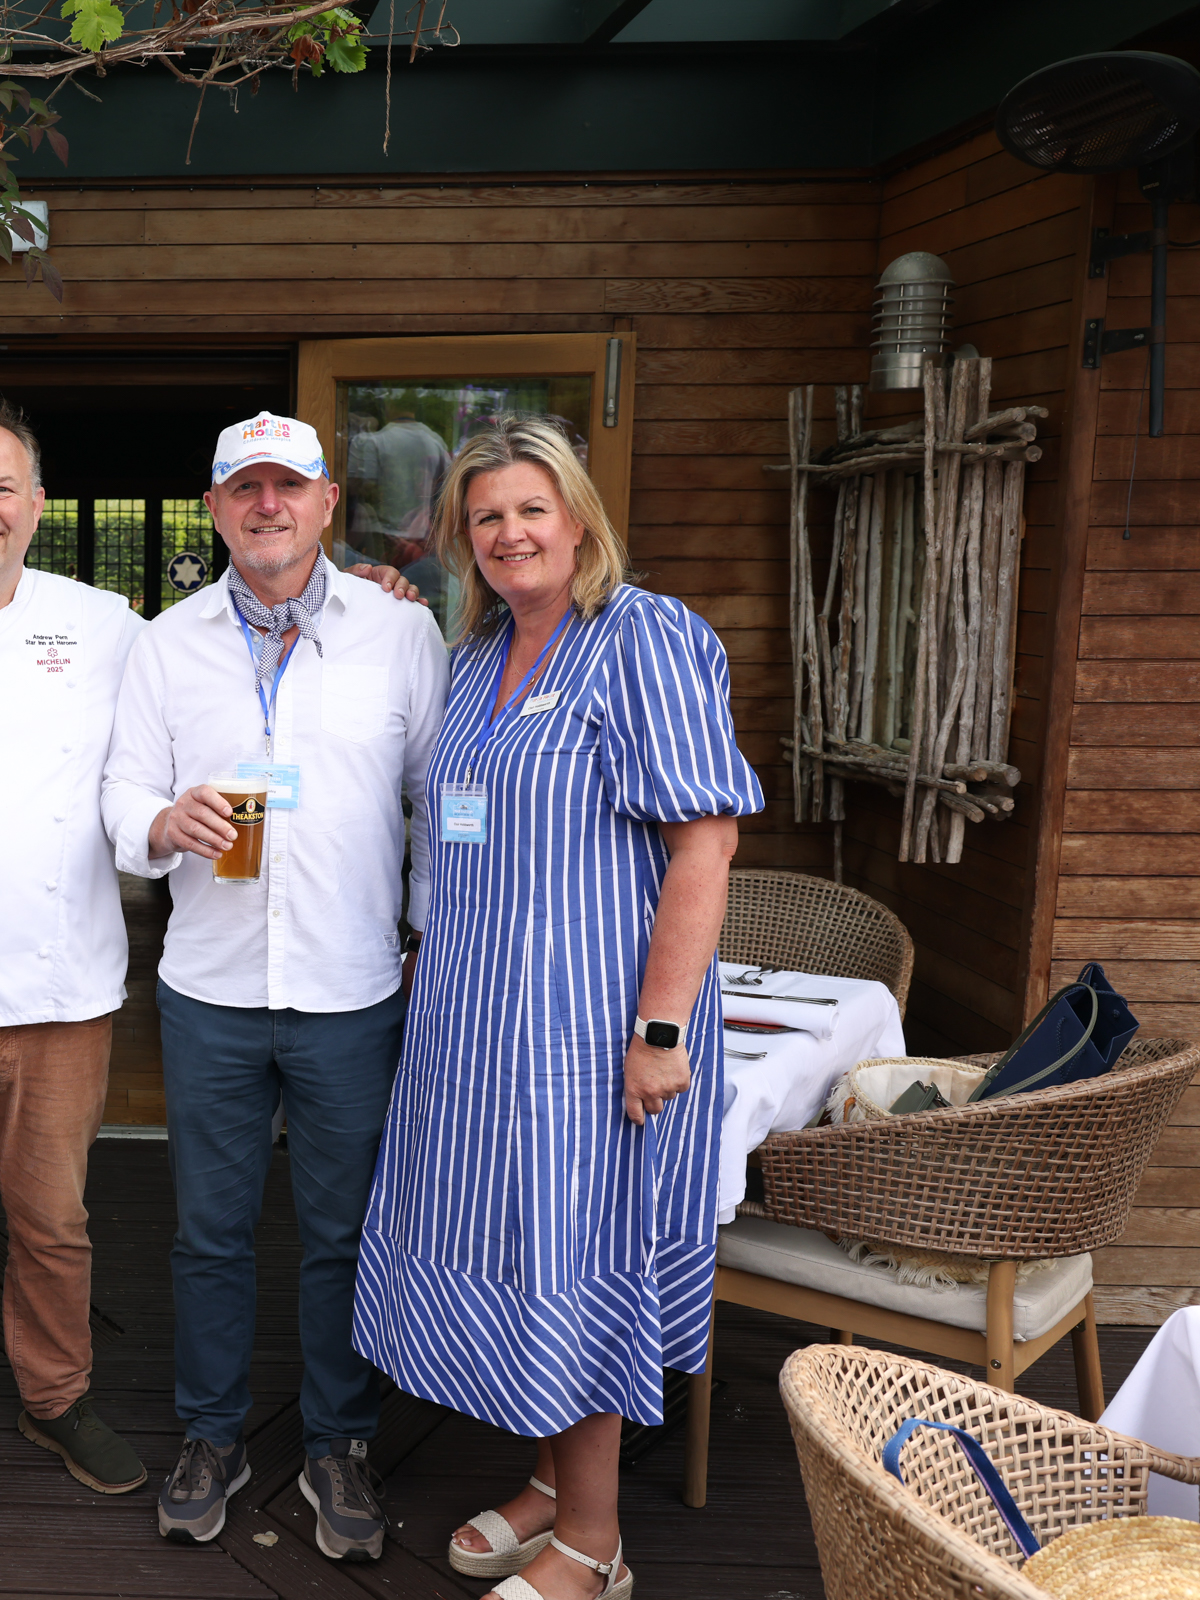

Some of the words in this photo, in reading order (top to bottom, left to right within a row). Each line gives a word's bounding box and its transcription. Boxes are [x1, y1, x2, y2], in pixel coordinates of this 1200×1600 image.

[242, 419, 290, 431] Martin
[243, 428, 290, 439] House
[36, 658, 71, 666] MICHELIN
